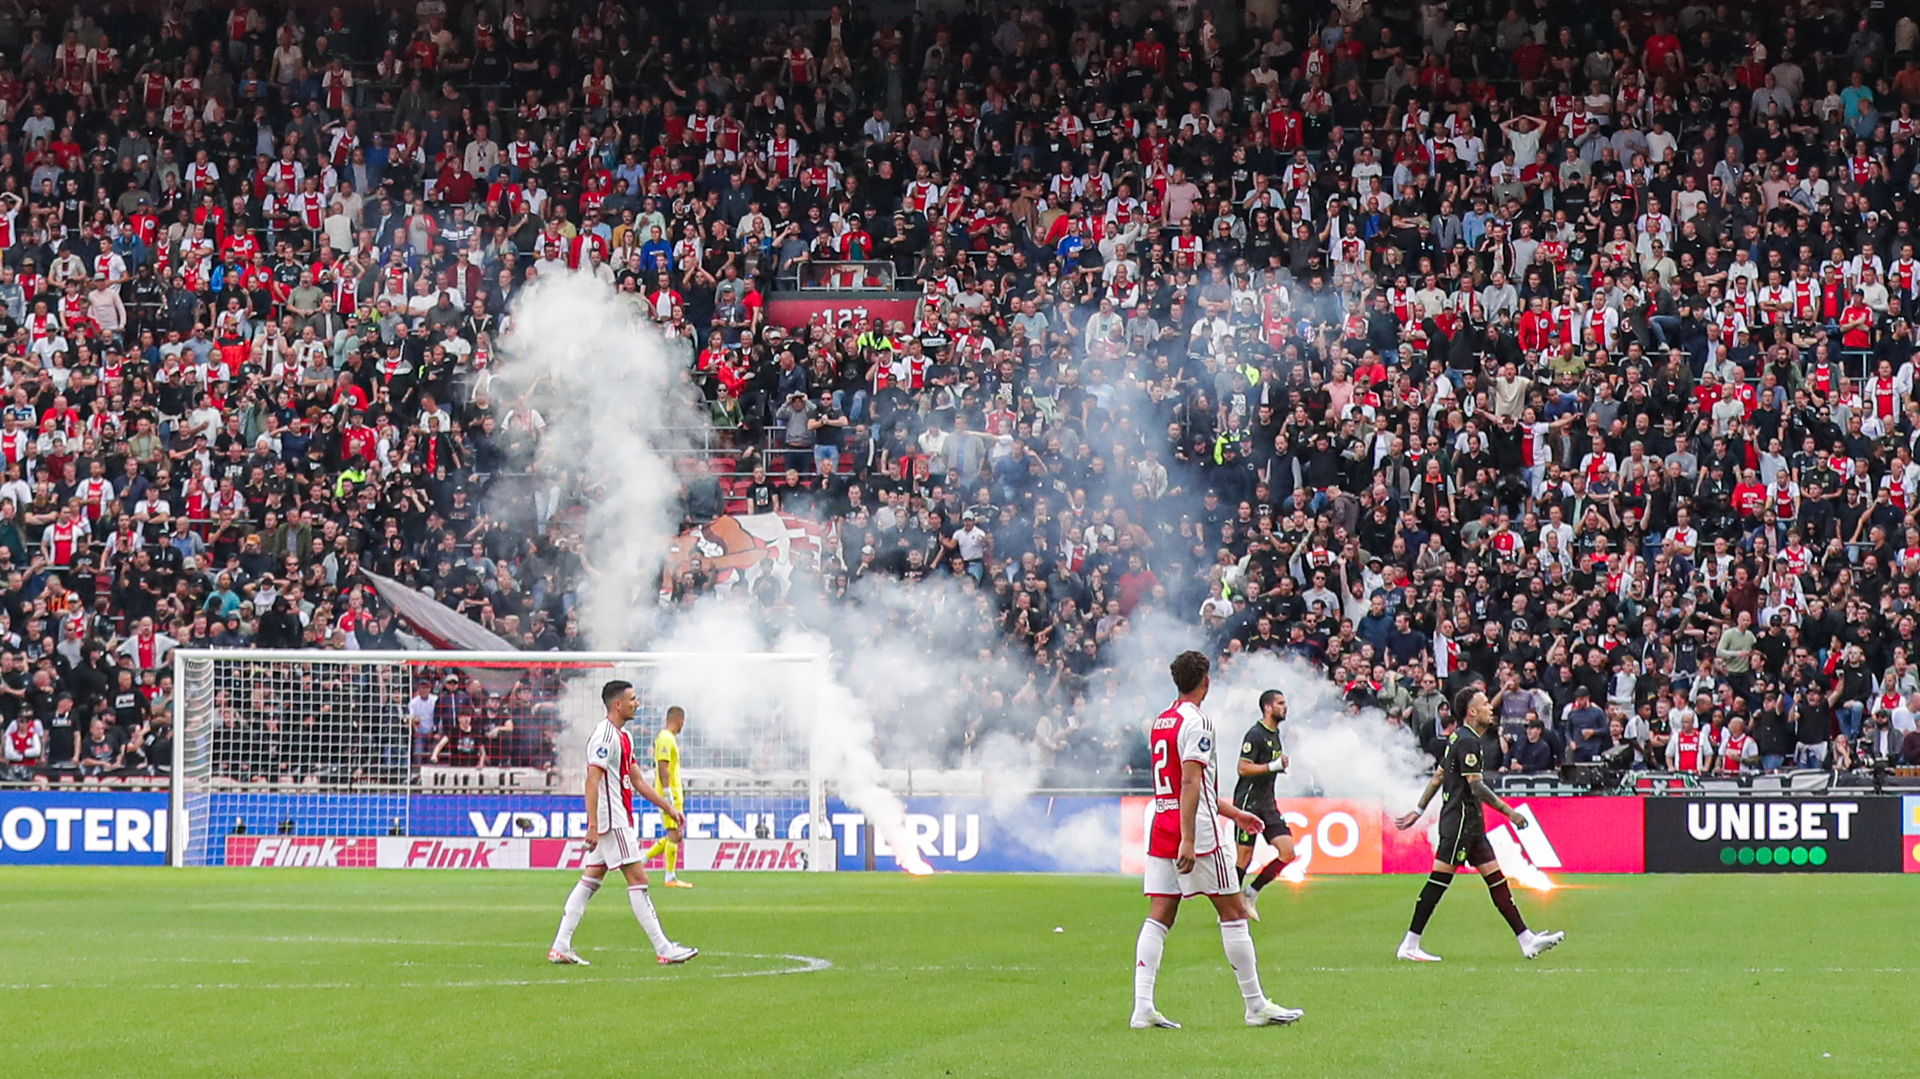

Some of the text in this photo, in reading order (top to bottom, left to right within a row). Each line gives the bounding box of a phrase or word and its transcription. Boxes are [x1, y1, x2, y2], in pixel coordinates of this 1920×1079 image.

[822, 308, 869, 330] 127
[1680, 743, 1697, 751] TDK
[1154, 739, 1174, 795] 2
[0, 806, 189, 853] OTERI
[1687, 803, 1859, 841] UNIBET
[251, 838, 350, 867] Flink
[405, 840, 502, 868] Flink
[711, 841, 806, 870] Flink
